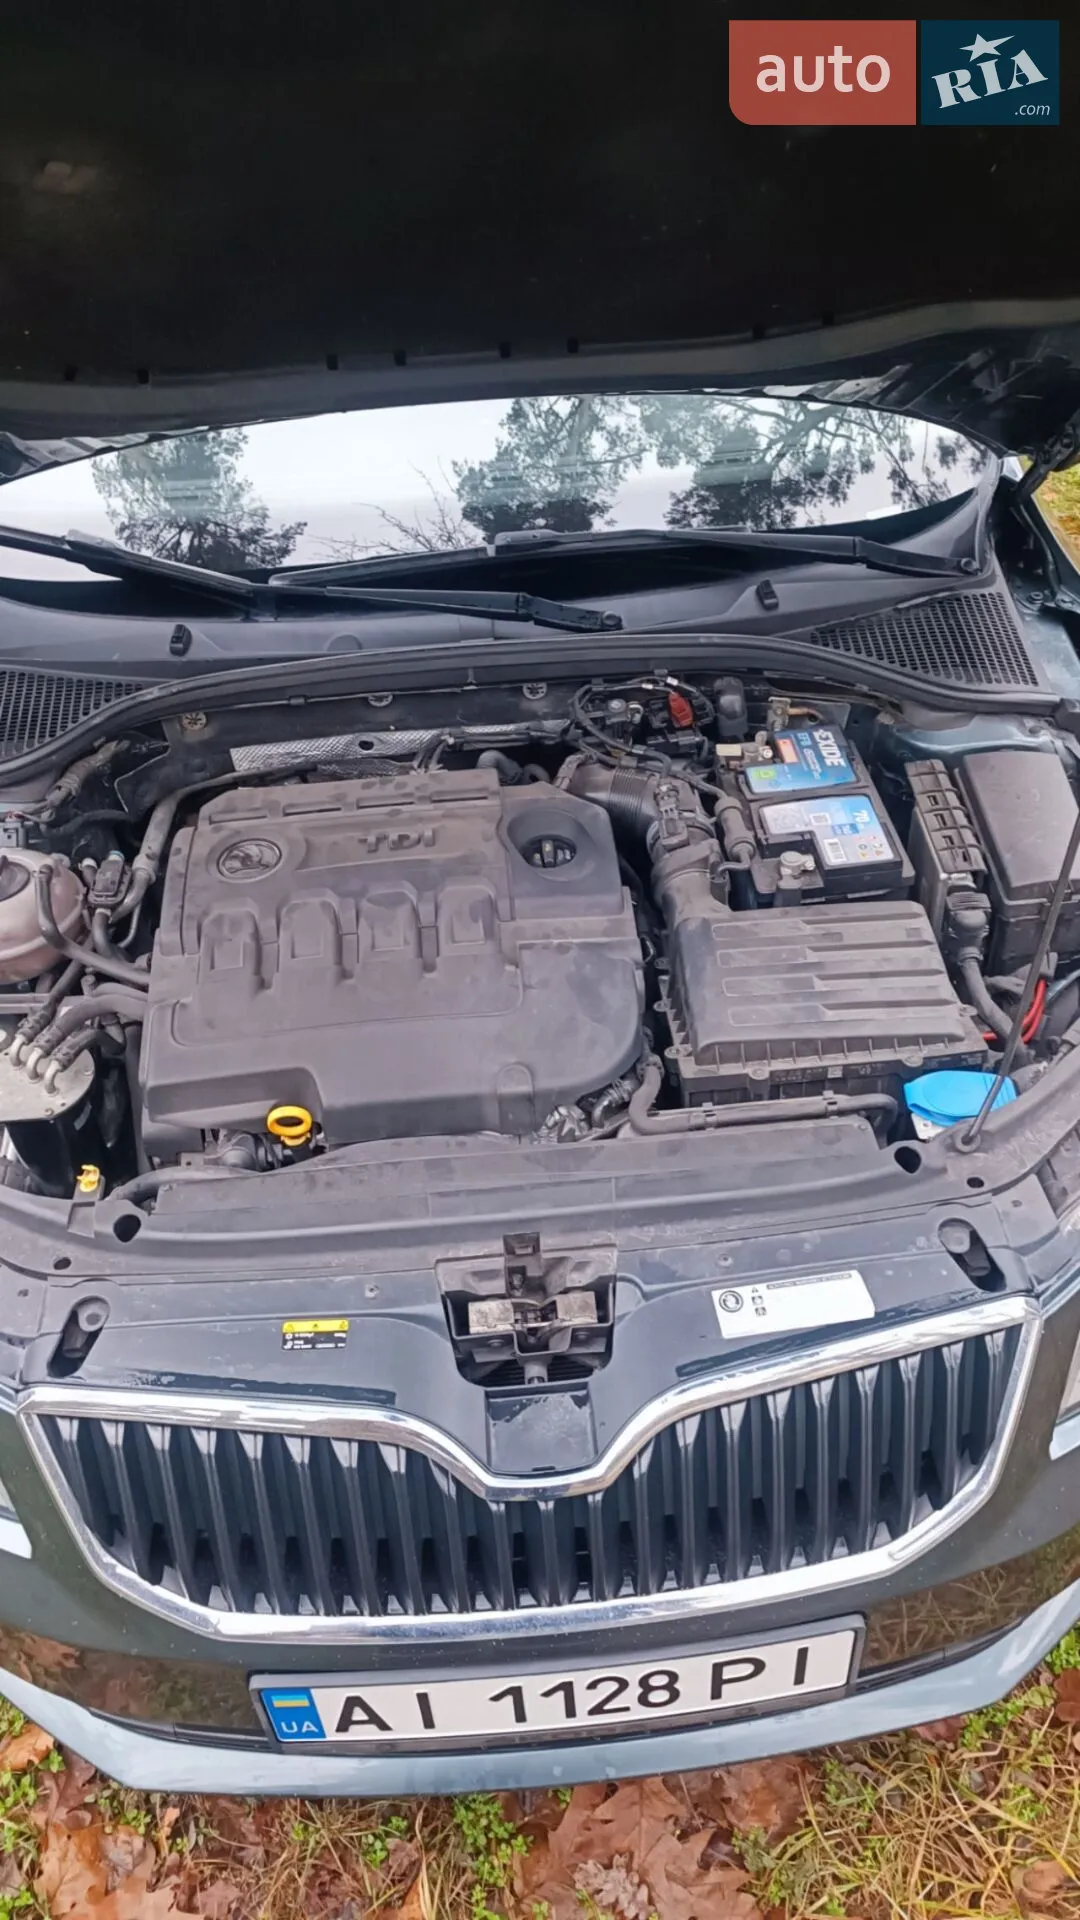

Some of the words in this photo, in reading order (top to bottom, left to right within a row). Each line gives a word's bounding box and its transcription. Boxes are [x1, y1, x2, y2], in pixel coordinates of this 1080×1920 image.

[812, 729, 847, 768] EXIDE
[358, 828, 436, 853] TDI
[333, 1691, 436, 1734] AI
[488, 1668, 682, 1724] 1128
[709, 1646, 811, 1701] PI
[281, 1720, 320, 1735] UA
